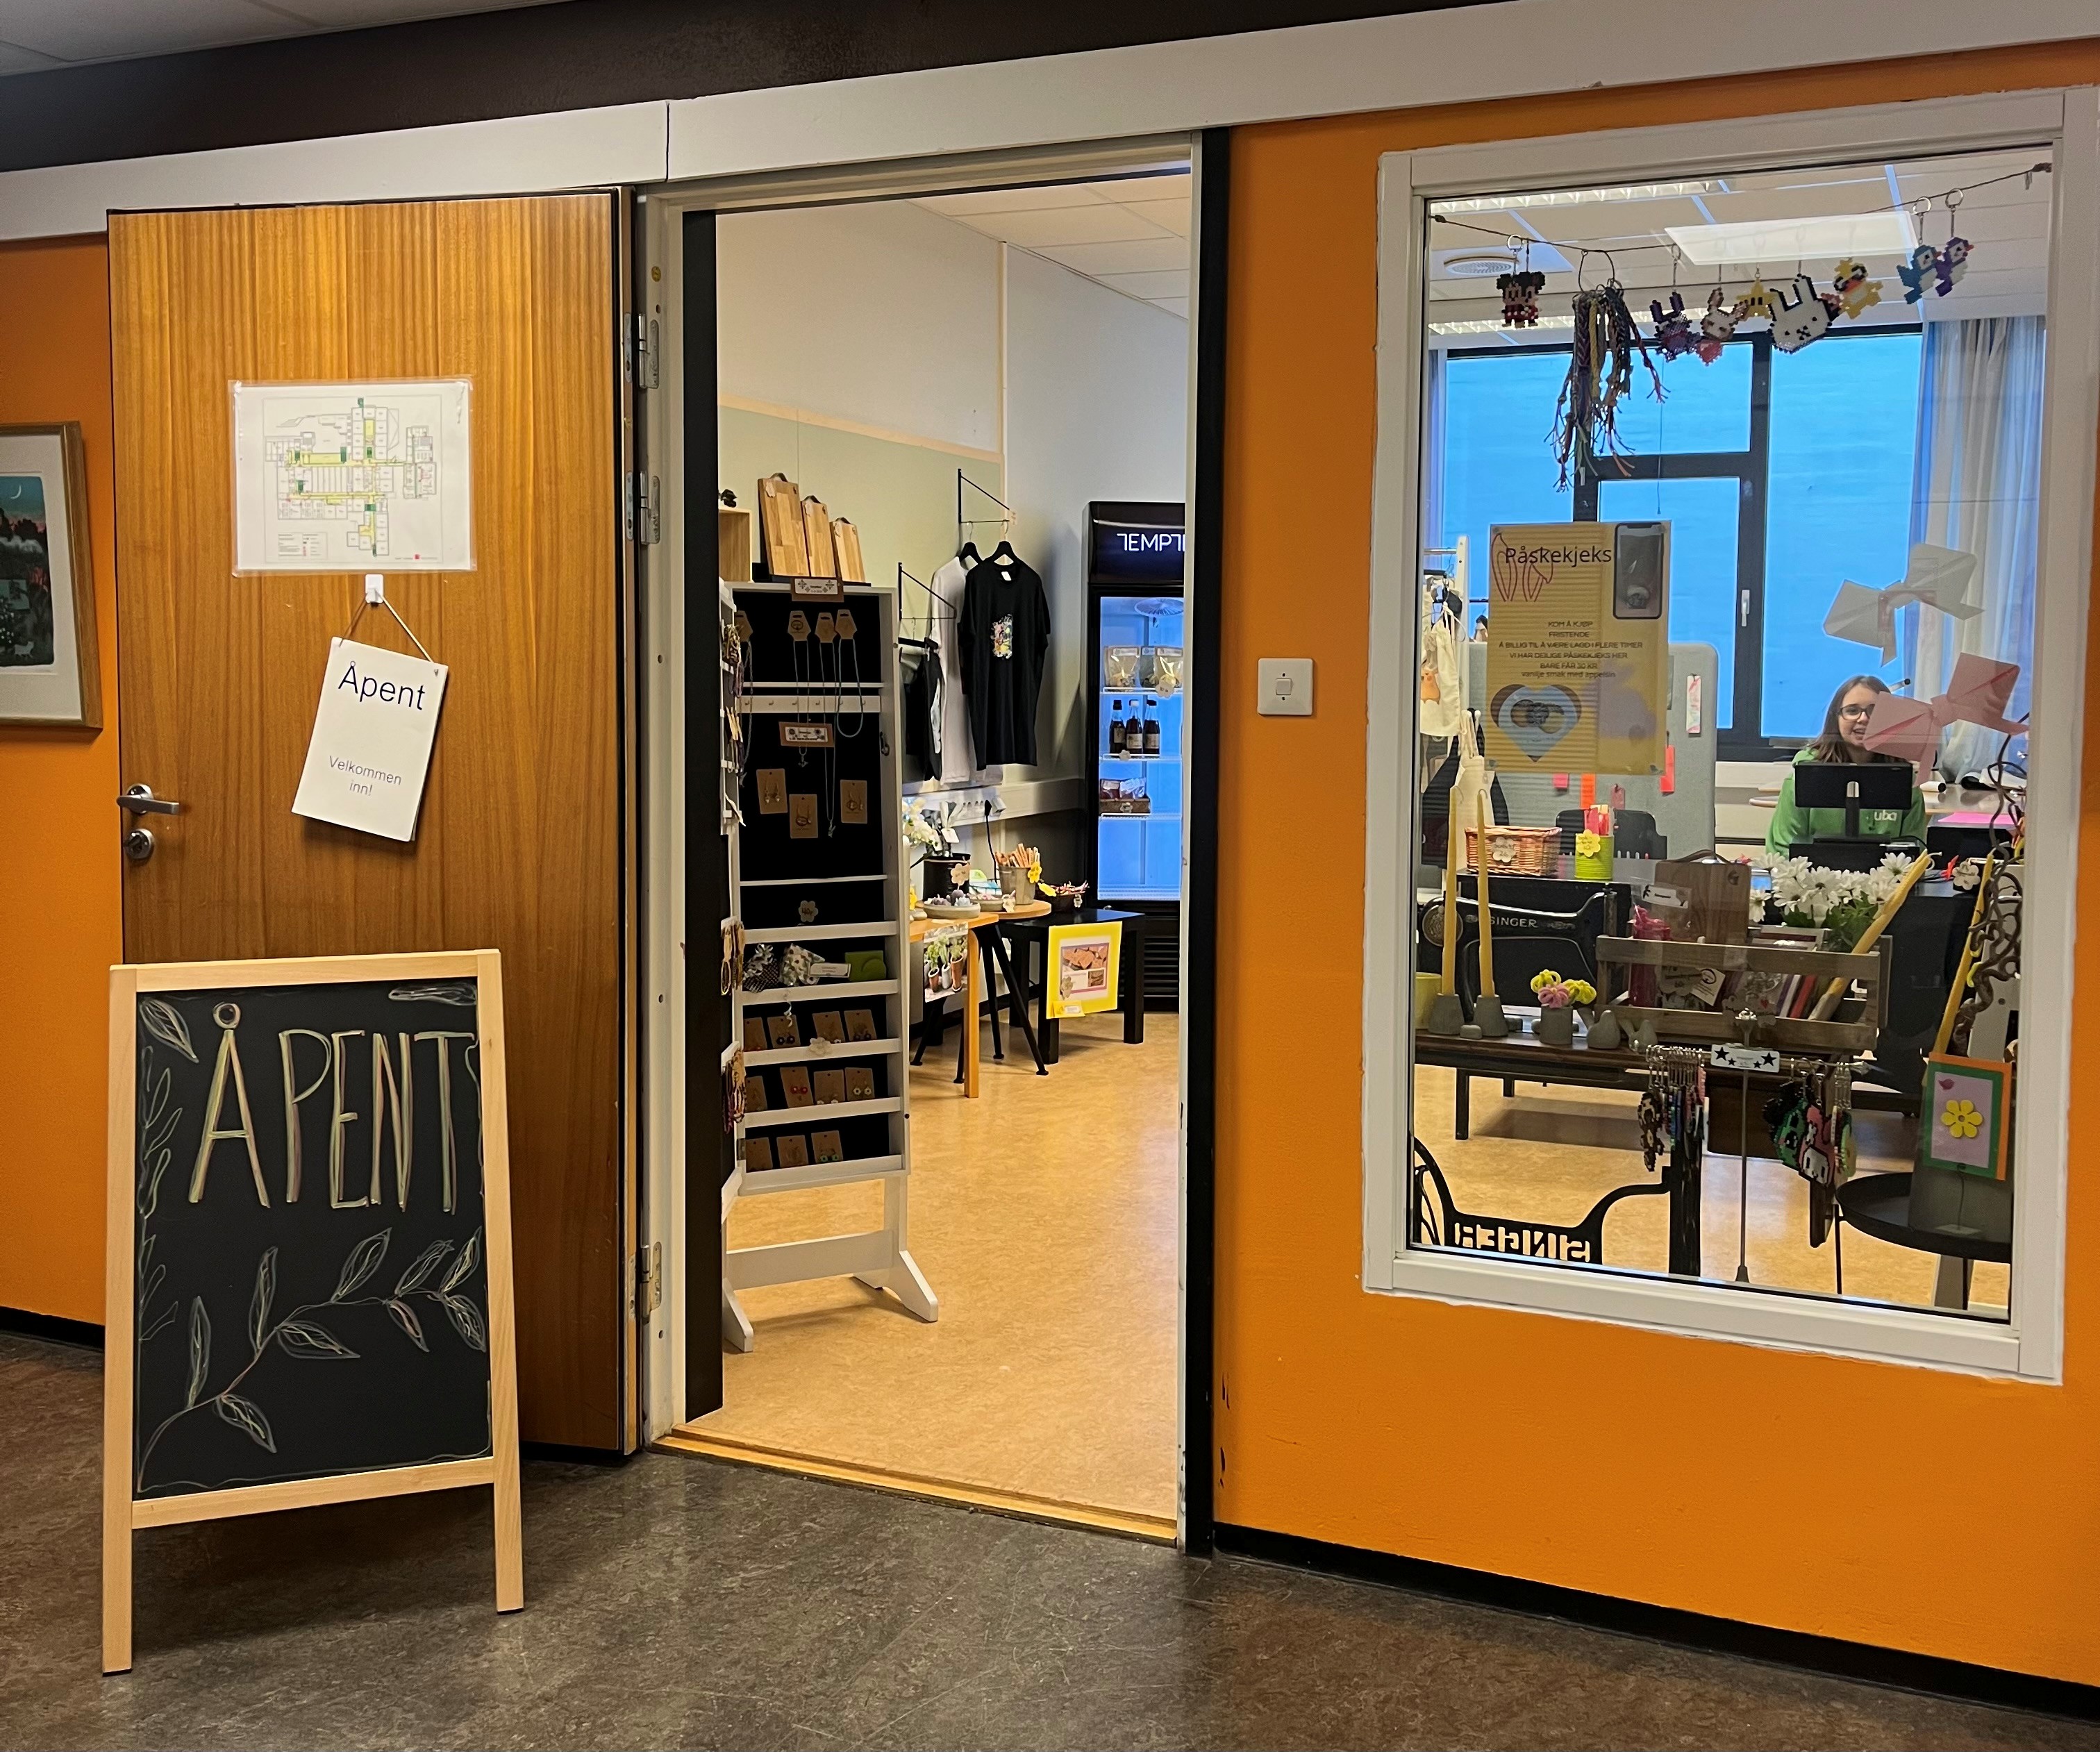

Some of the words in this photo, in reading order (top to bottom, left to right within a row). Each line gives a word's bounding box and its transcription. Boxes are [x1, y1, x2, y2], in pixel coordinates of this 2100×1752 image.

[1505, 545, 1612, 568] Påskekjeks
[338, 660, 426, 710] Åpent
[328, 755, 402, 785] Velkommen
[349, 779, 373, 796] inn!
[1490, 916, 1540, 928] SINGER
[188, 1001, 475, 1215] ÅPENT
